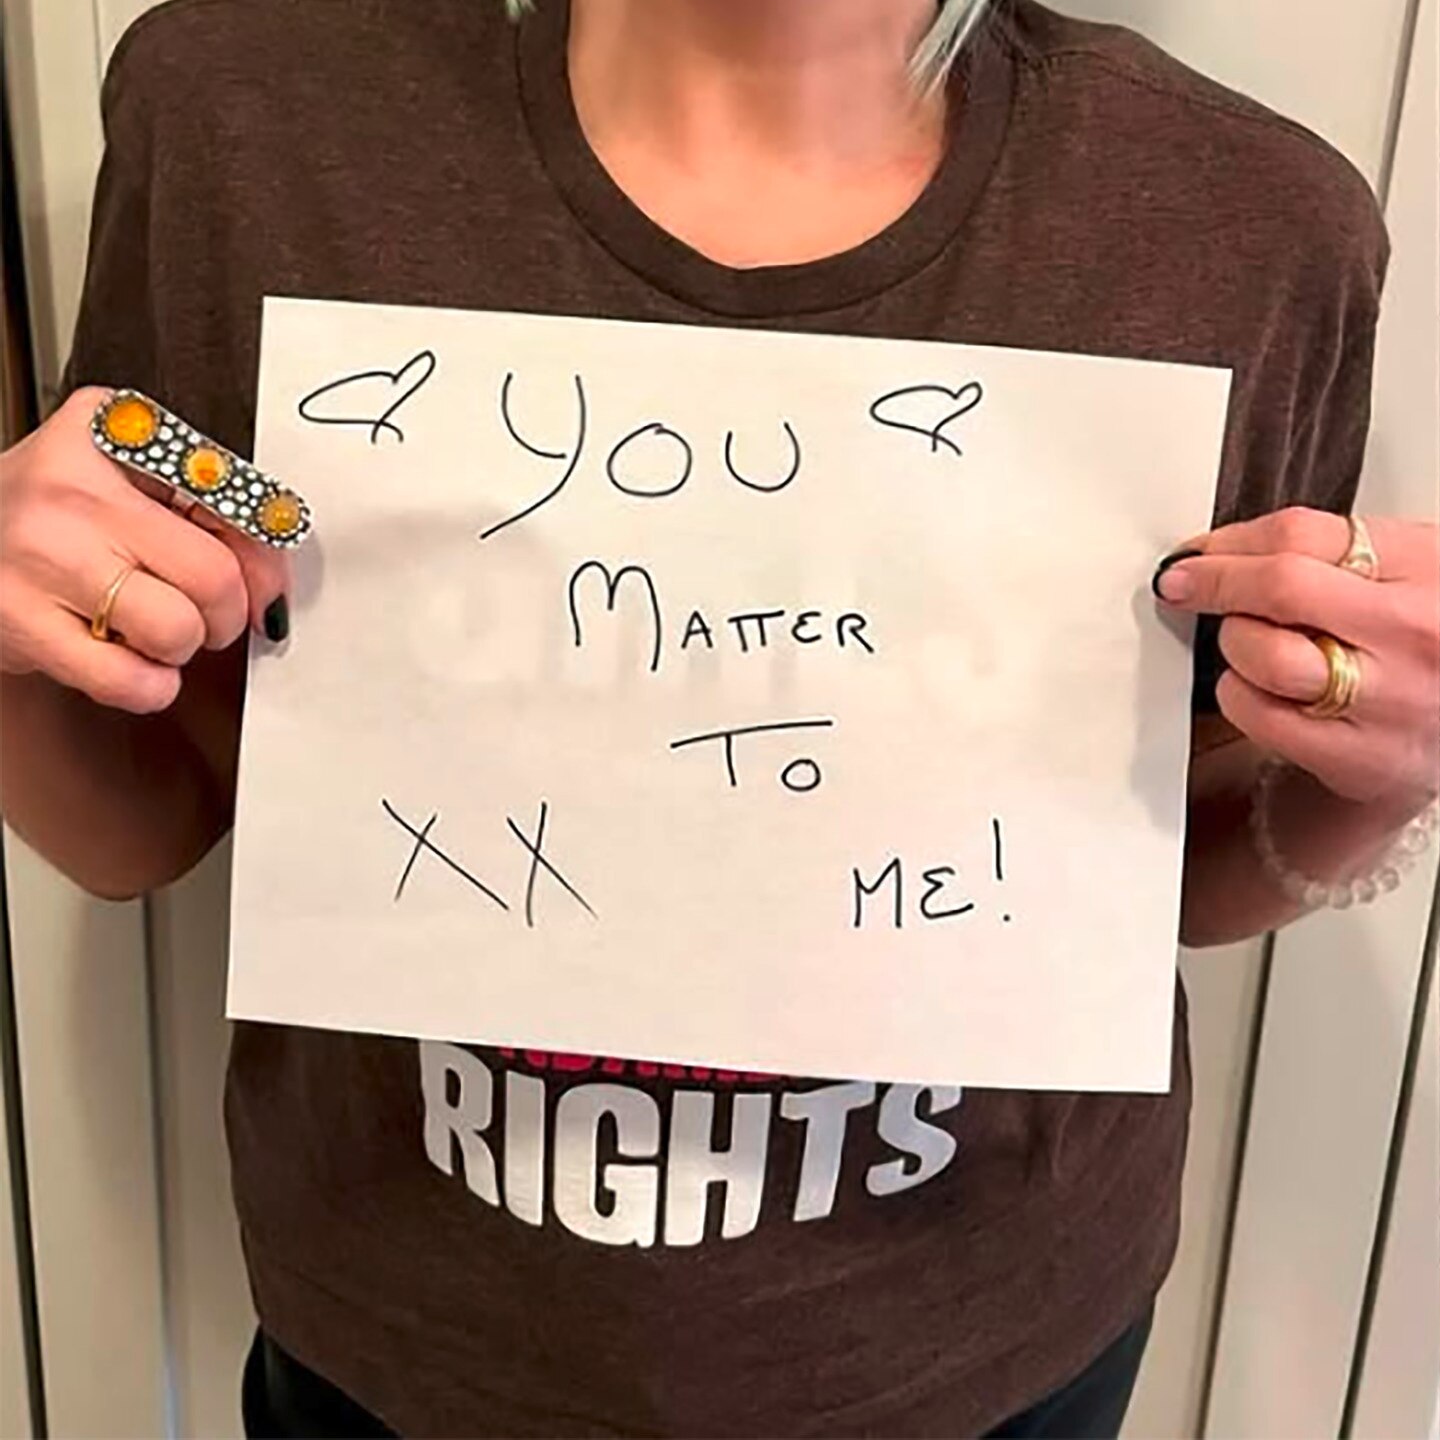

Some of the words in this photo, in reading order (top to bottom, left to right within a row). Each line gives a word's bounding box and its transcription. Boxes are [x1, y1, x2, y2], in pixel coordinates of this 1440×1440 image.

[481, 372, 801, 539] YOU
[568, 561, 875, 671] MATTER
[670, 719, 833, 791] TO
[853, 817, 1012, 928] ME!
[418, 1039, 962, 1248] RIGHTS
